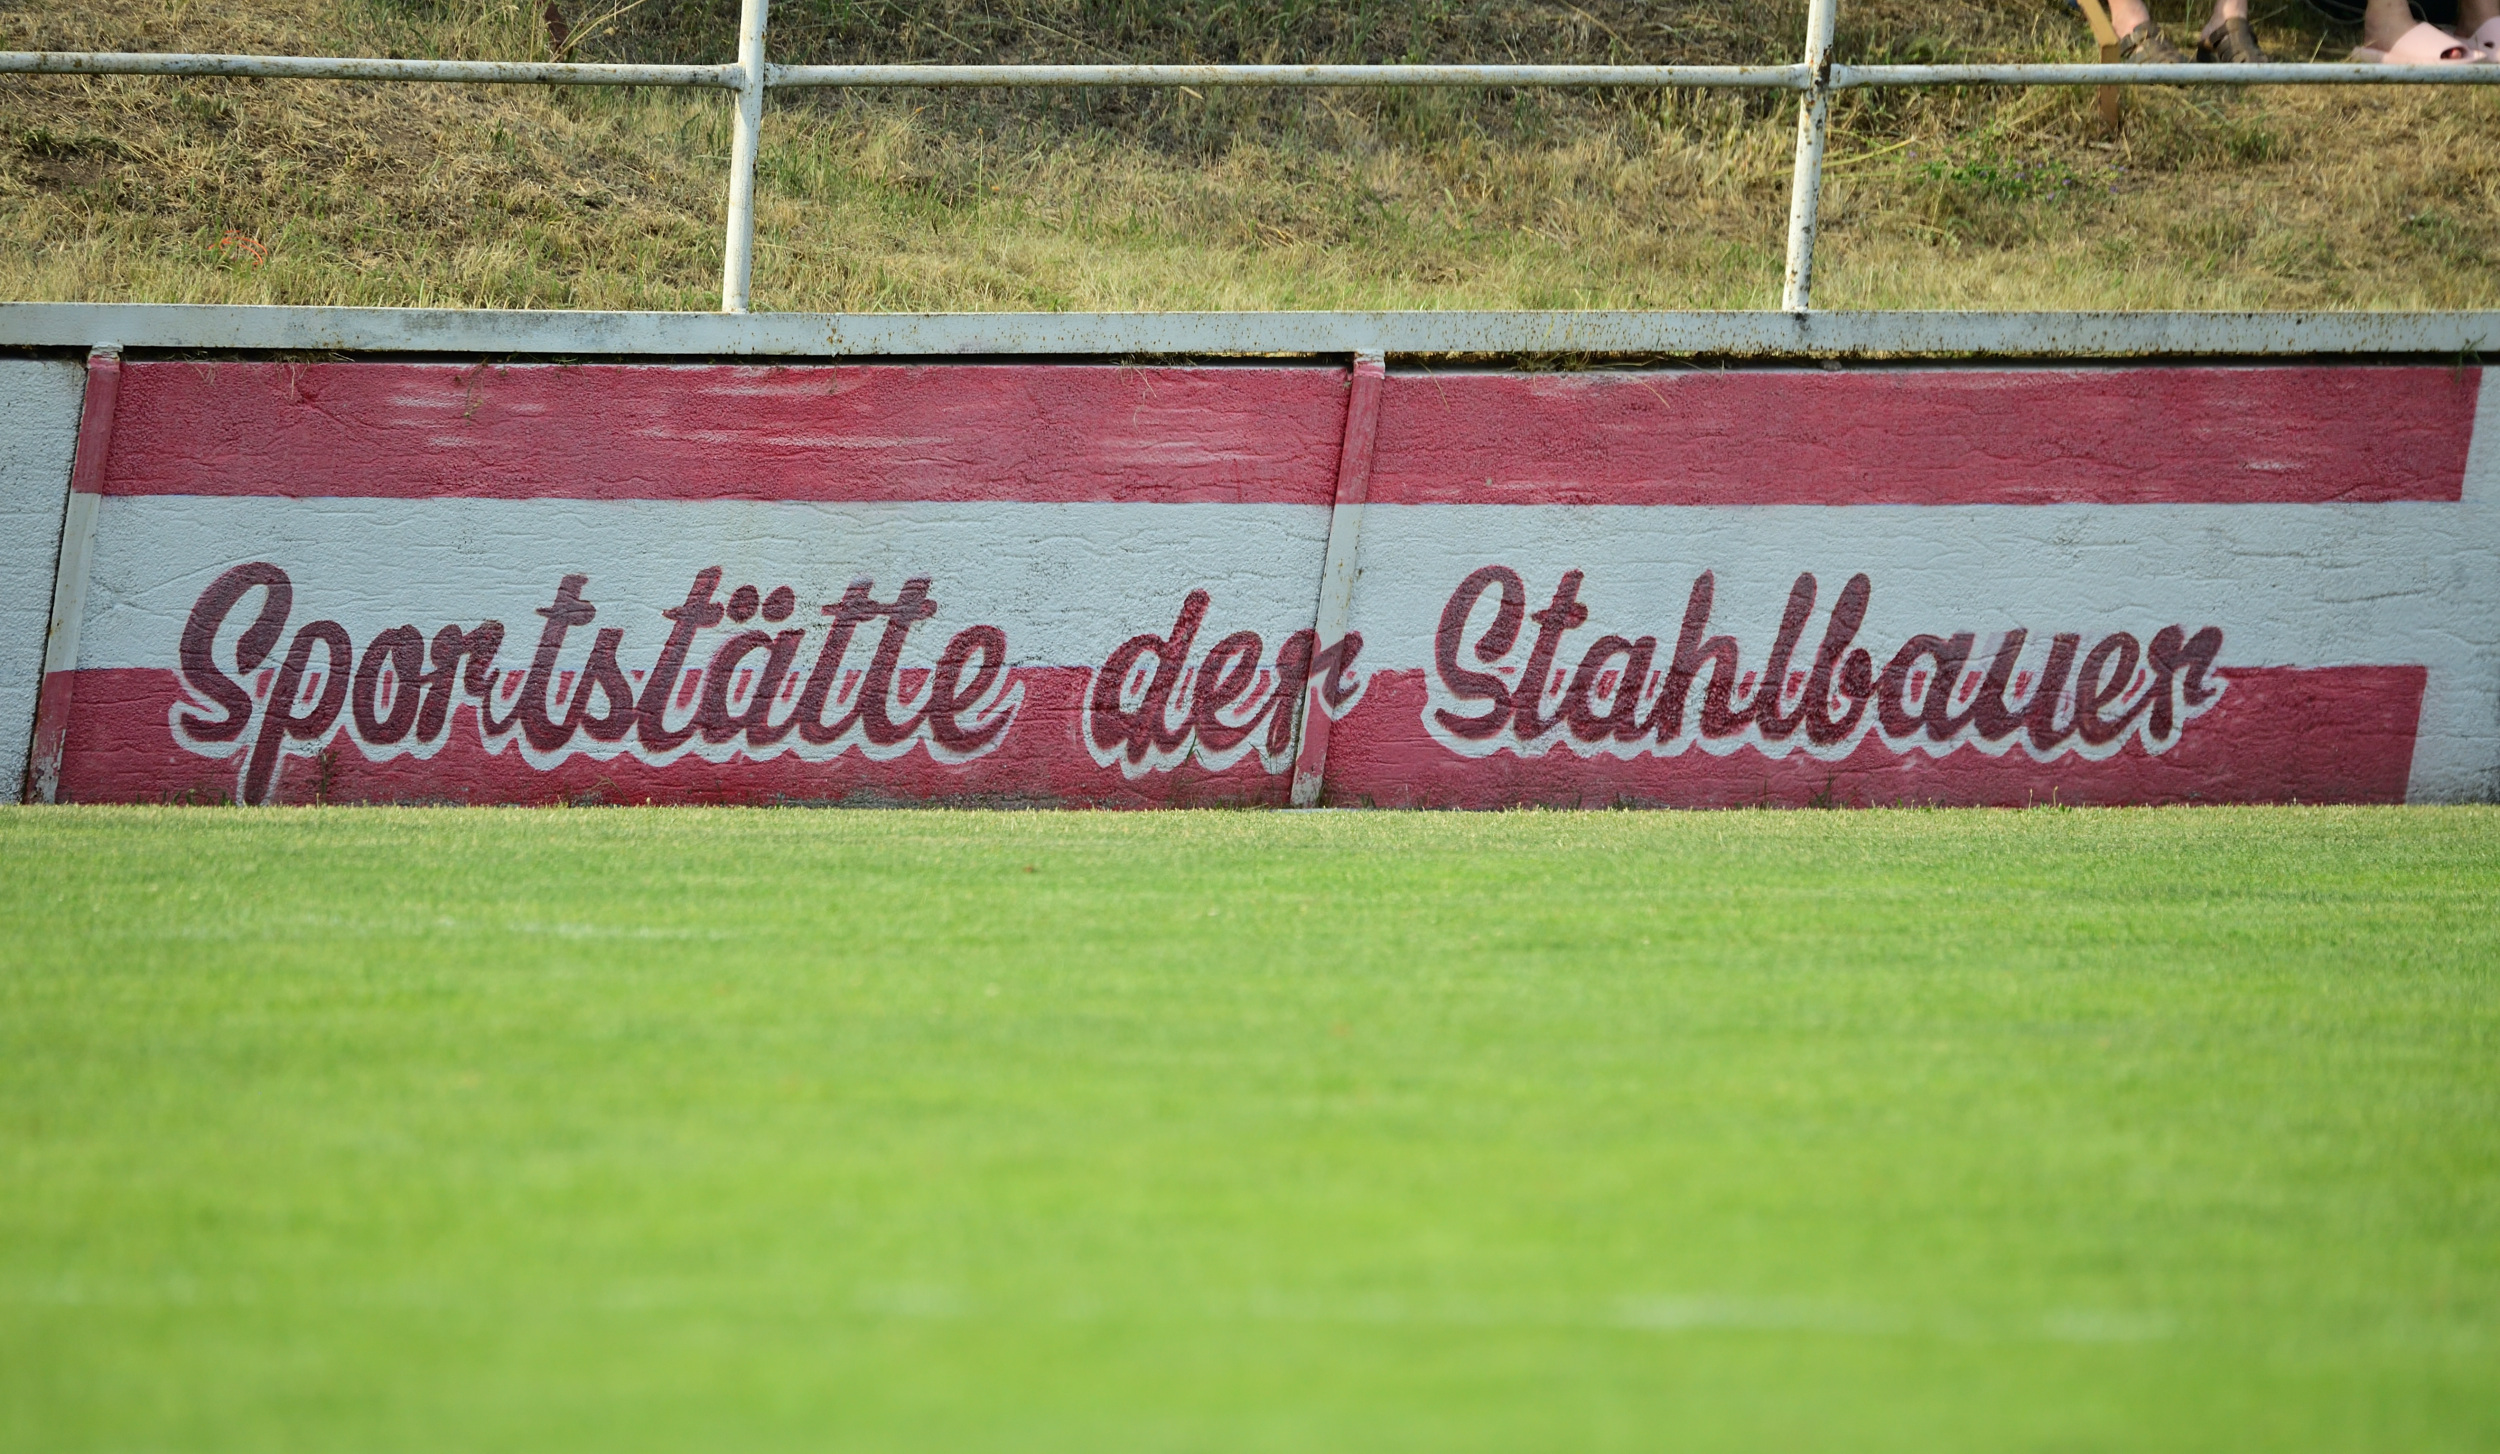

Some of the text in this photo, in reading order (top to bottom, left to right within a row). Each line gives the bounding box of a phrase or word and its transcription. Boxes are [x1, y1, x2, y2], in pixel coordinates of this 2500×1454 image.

[177, 561, 2223, 804] Sportstätte der Stahlbauer
